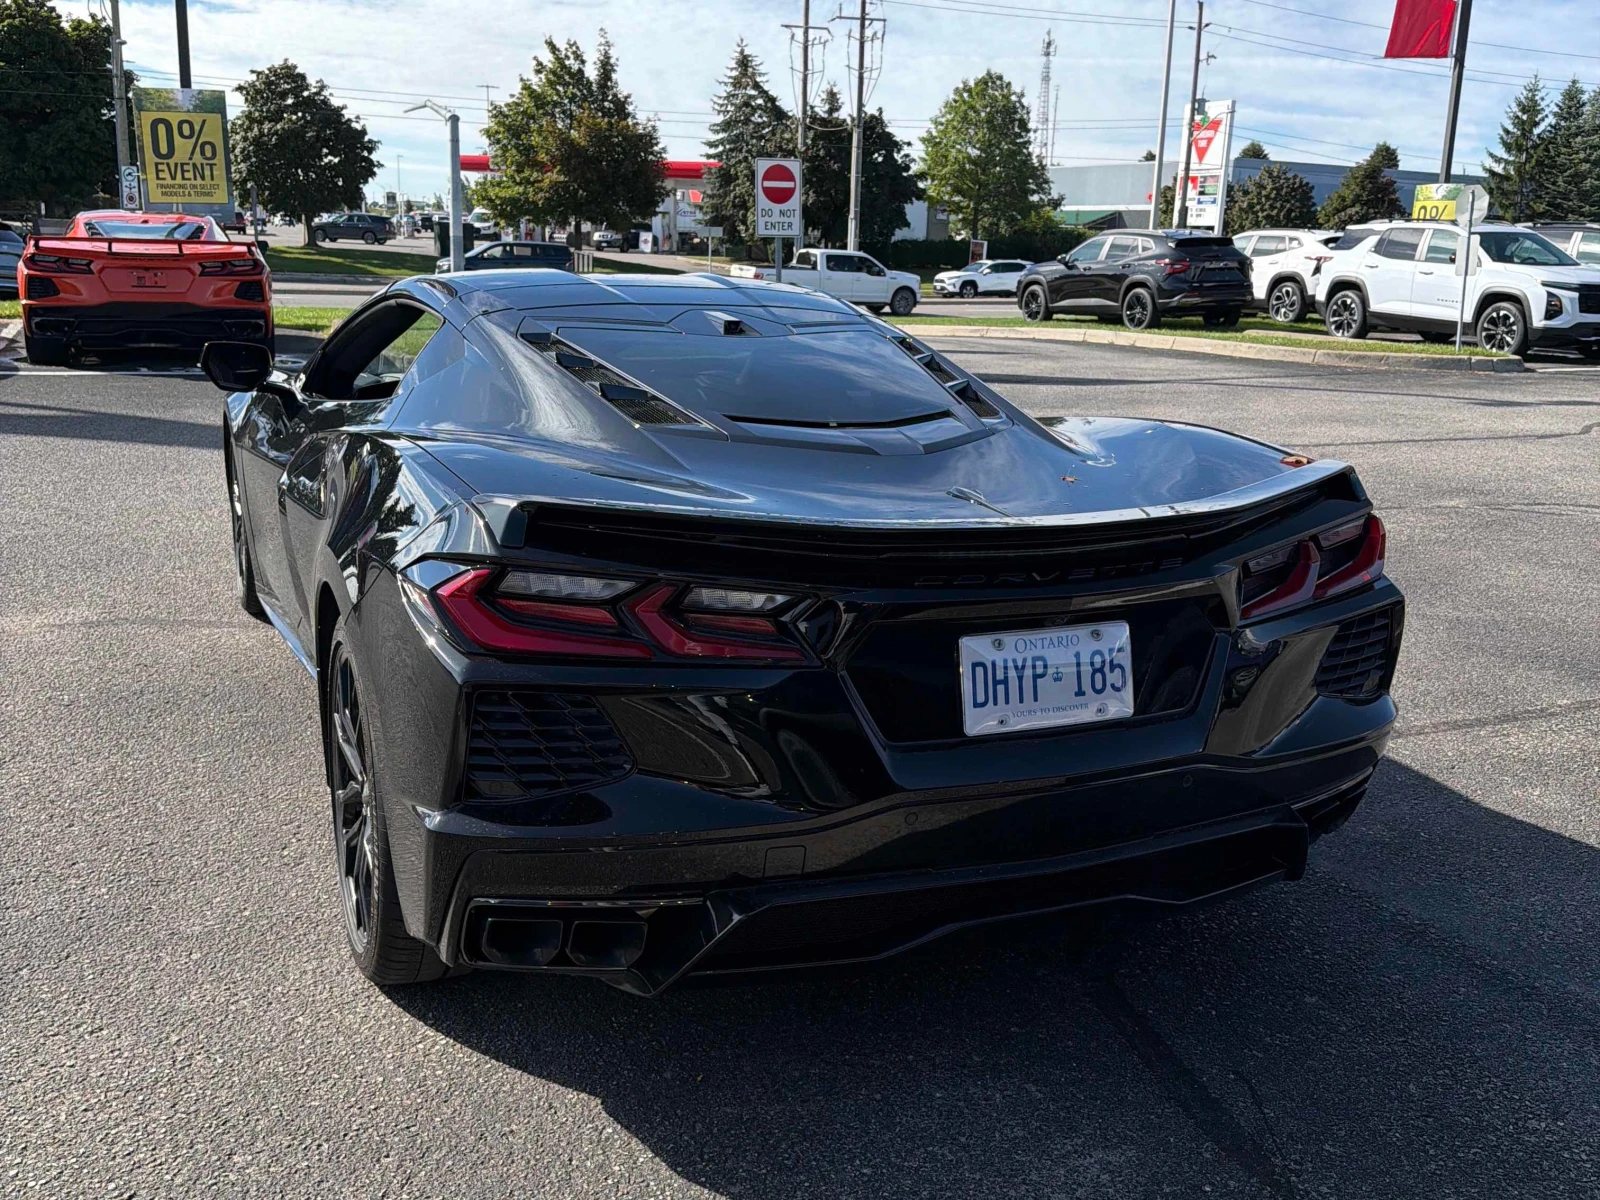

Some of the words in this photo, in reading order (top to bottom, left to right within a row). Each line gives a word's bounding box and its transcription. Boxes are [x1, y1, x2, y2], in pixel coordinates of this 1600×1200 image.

[150, 117, 217, 161] 0%
[154, 162, 217, 181] EVENT
[156, 183, 188, 191] FINANCING
[189, 183, 198, 191] ON
[199, 183, 220, 191] SELECT
[761, 208, 774, 218] DO
[779, 208, 797, 218] NOT
[764, 221, 793, 232] ENTER
[1014, 634, 1081, 654] ONTARIO
[970, 655, 1049, 709] DHYP
[1073, 647, 1128, 698] 185
[1011, 709, 1037, 719] YOURS
[1040, 707, 1051, 716] TO
[1052, 702, 1090, 714] DISCOVER
